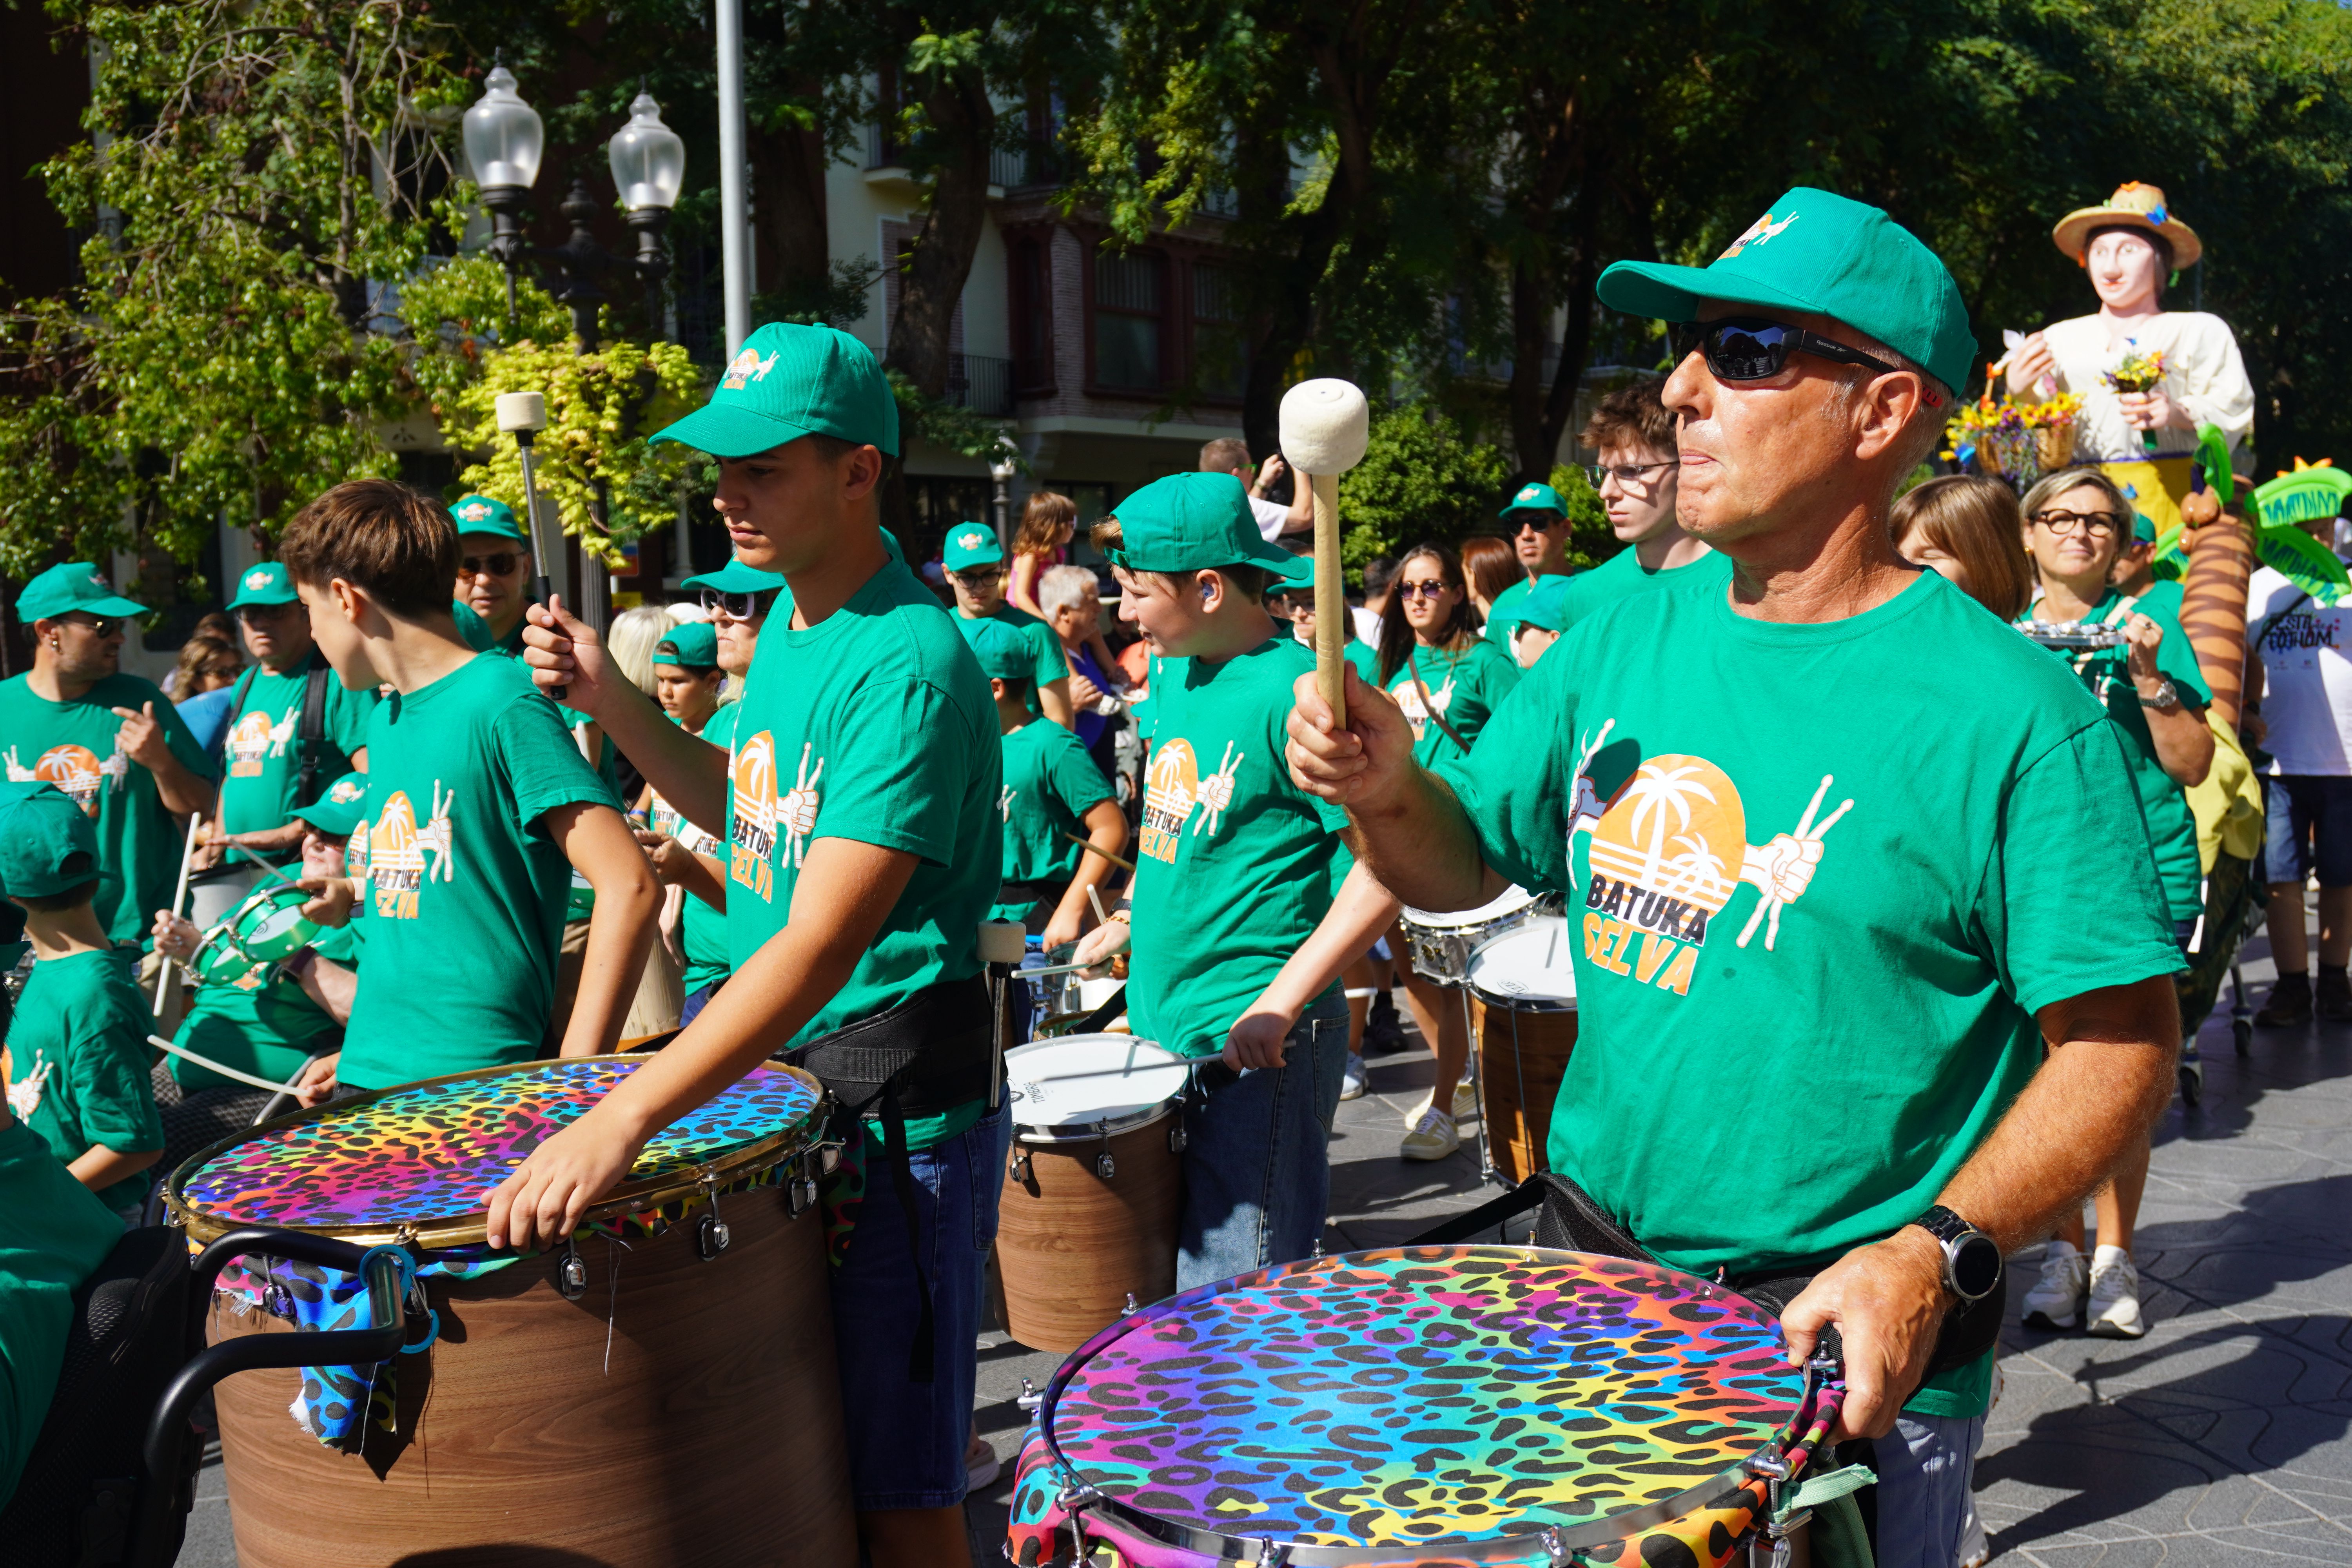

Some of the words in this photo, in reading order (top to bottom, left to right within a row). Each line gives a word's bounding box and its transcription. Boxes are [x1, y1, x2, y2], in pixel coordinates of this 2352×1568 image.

[1816, 340, 1836, 350] Reebok
[654, 809, 676, 822] BATUK
[1144, 805, 1183, 837] BATUKA
[348, 849, 367, 866] BATUK
[1139, 825, 1178, 864] SELVA
[1585, 873, 1709, 947] BATUKA
[1583, 912, 1699, 996] SELVA
[1023, 1082, 1046, 1103] TIMBRA
